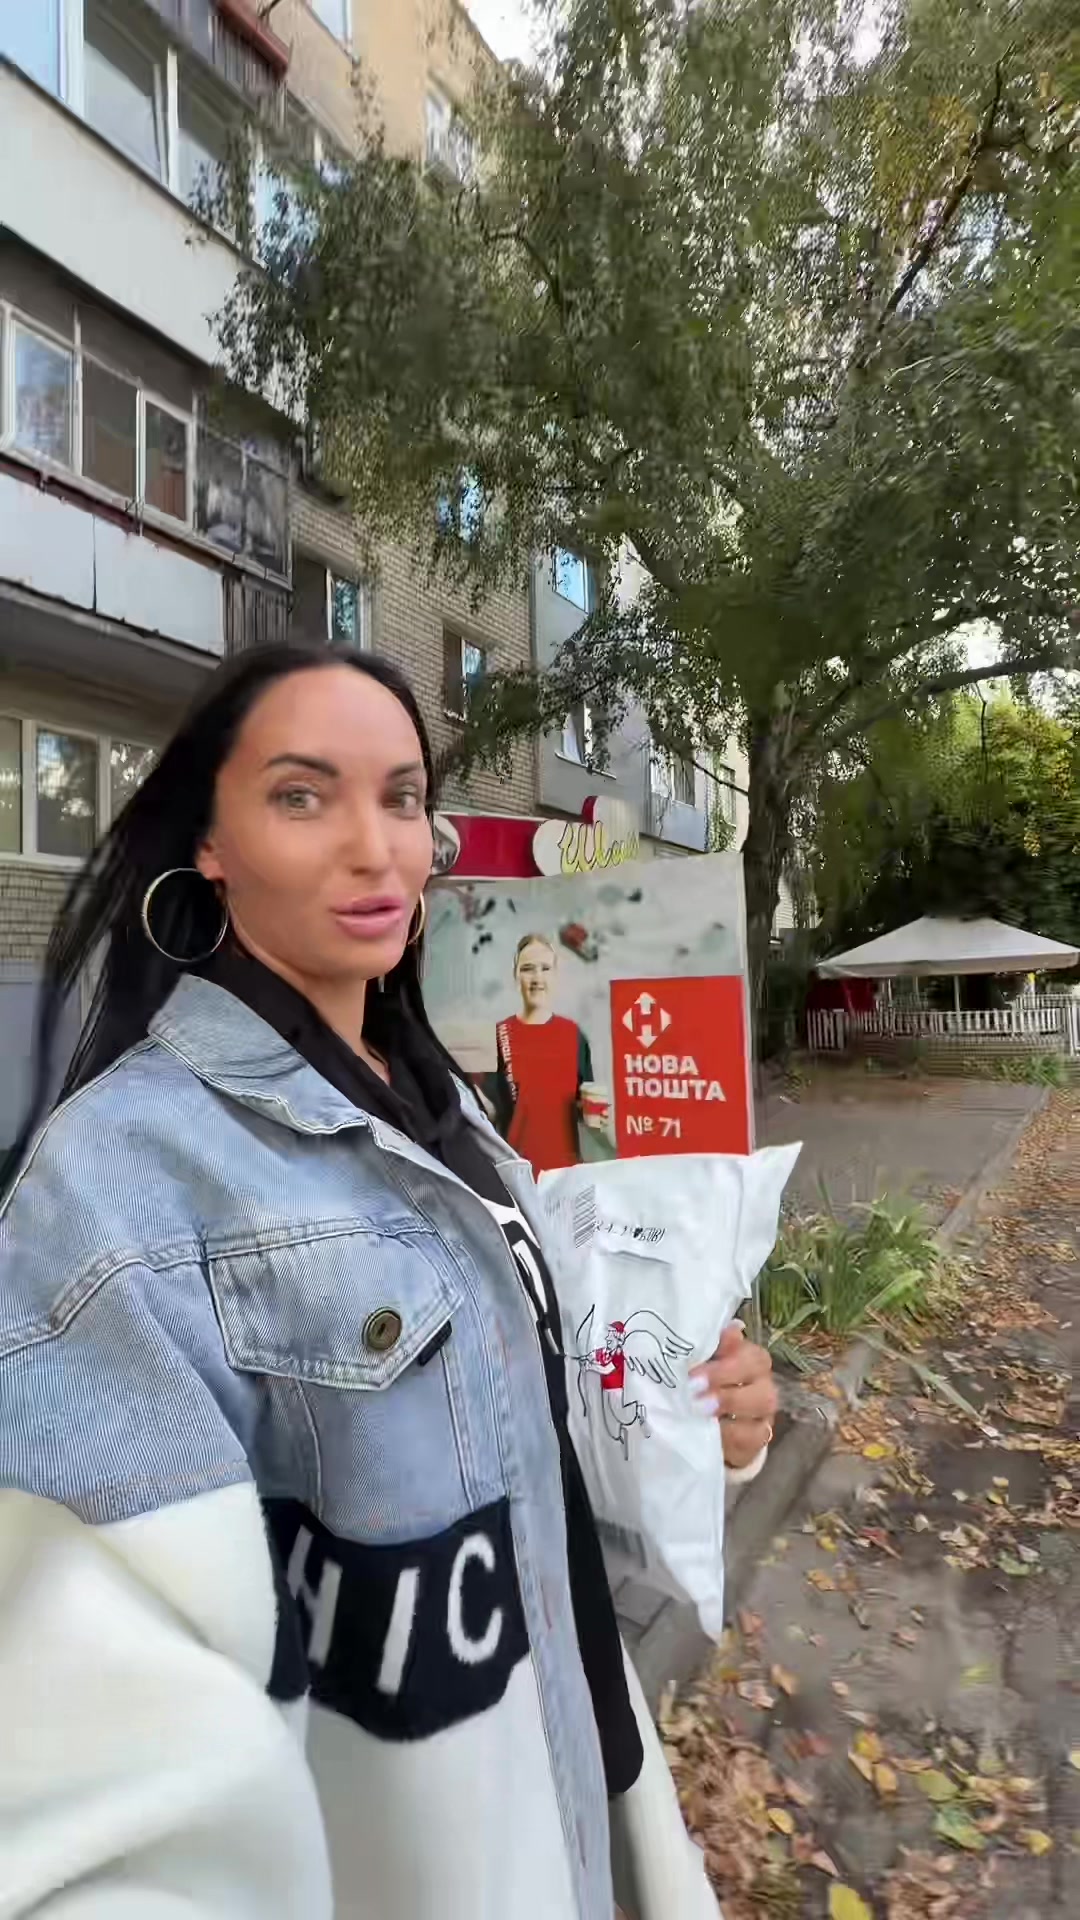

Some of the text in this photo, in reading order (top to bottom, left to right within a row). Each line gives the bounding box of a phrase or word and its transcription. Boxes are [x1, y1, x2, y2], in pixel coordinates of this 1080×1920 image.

[624, 1053, 699, 1075] НОВА
[624, 1077, 727, 1102] ПОШТА
[626, 1115, 681, 1138] № 71
